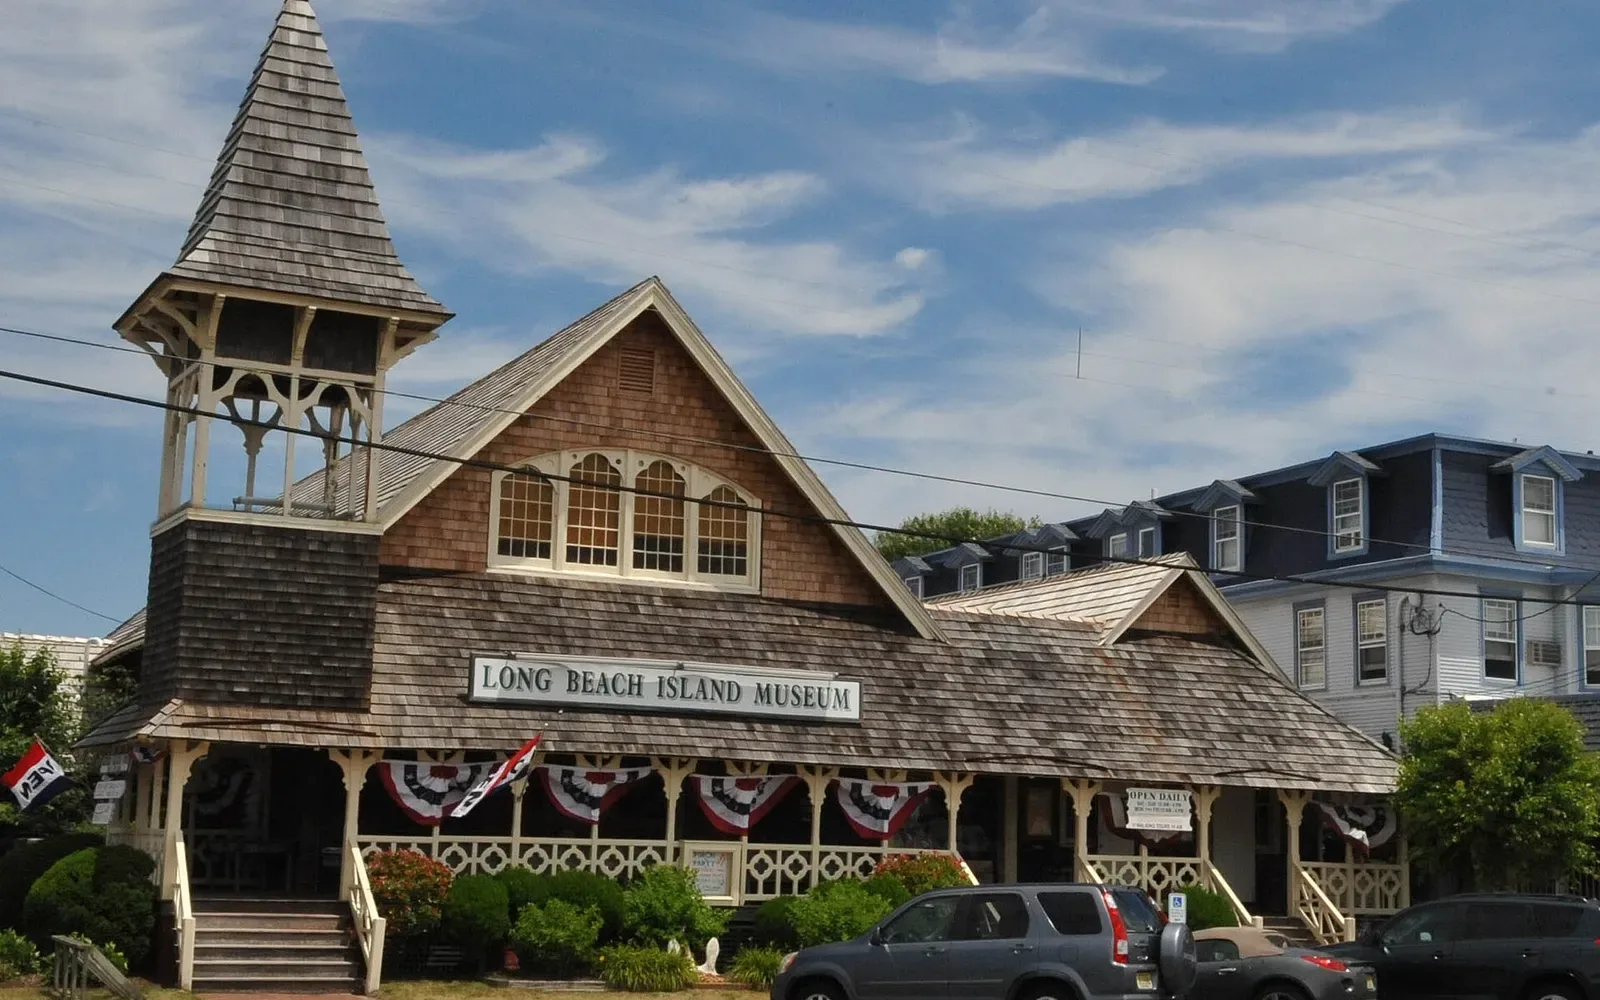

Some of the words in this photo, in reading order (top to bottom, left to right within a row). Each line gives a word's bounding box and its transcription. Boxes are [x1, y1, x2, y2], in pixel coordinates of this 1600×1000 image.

[482, 664, 552, 692] LONG
[566, 670, 643, 697] BEACH
[657, 675, 742, 702] ISLAND
[753, 681, 852, 710] MUSEUM
[1130, 791, 1156, 800] OPEN
[1159, 793, 1189, 802] DAILY
